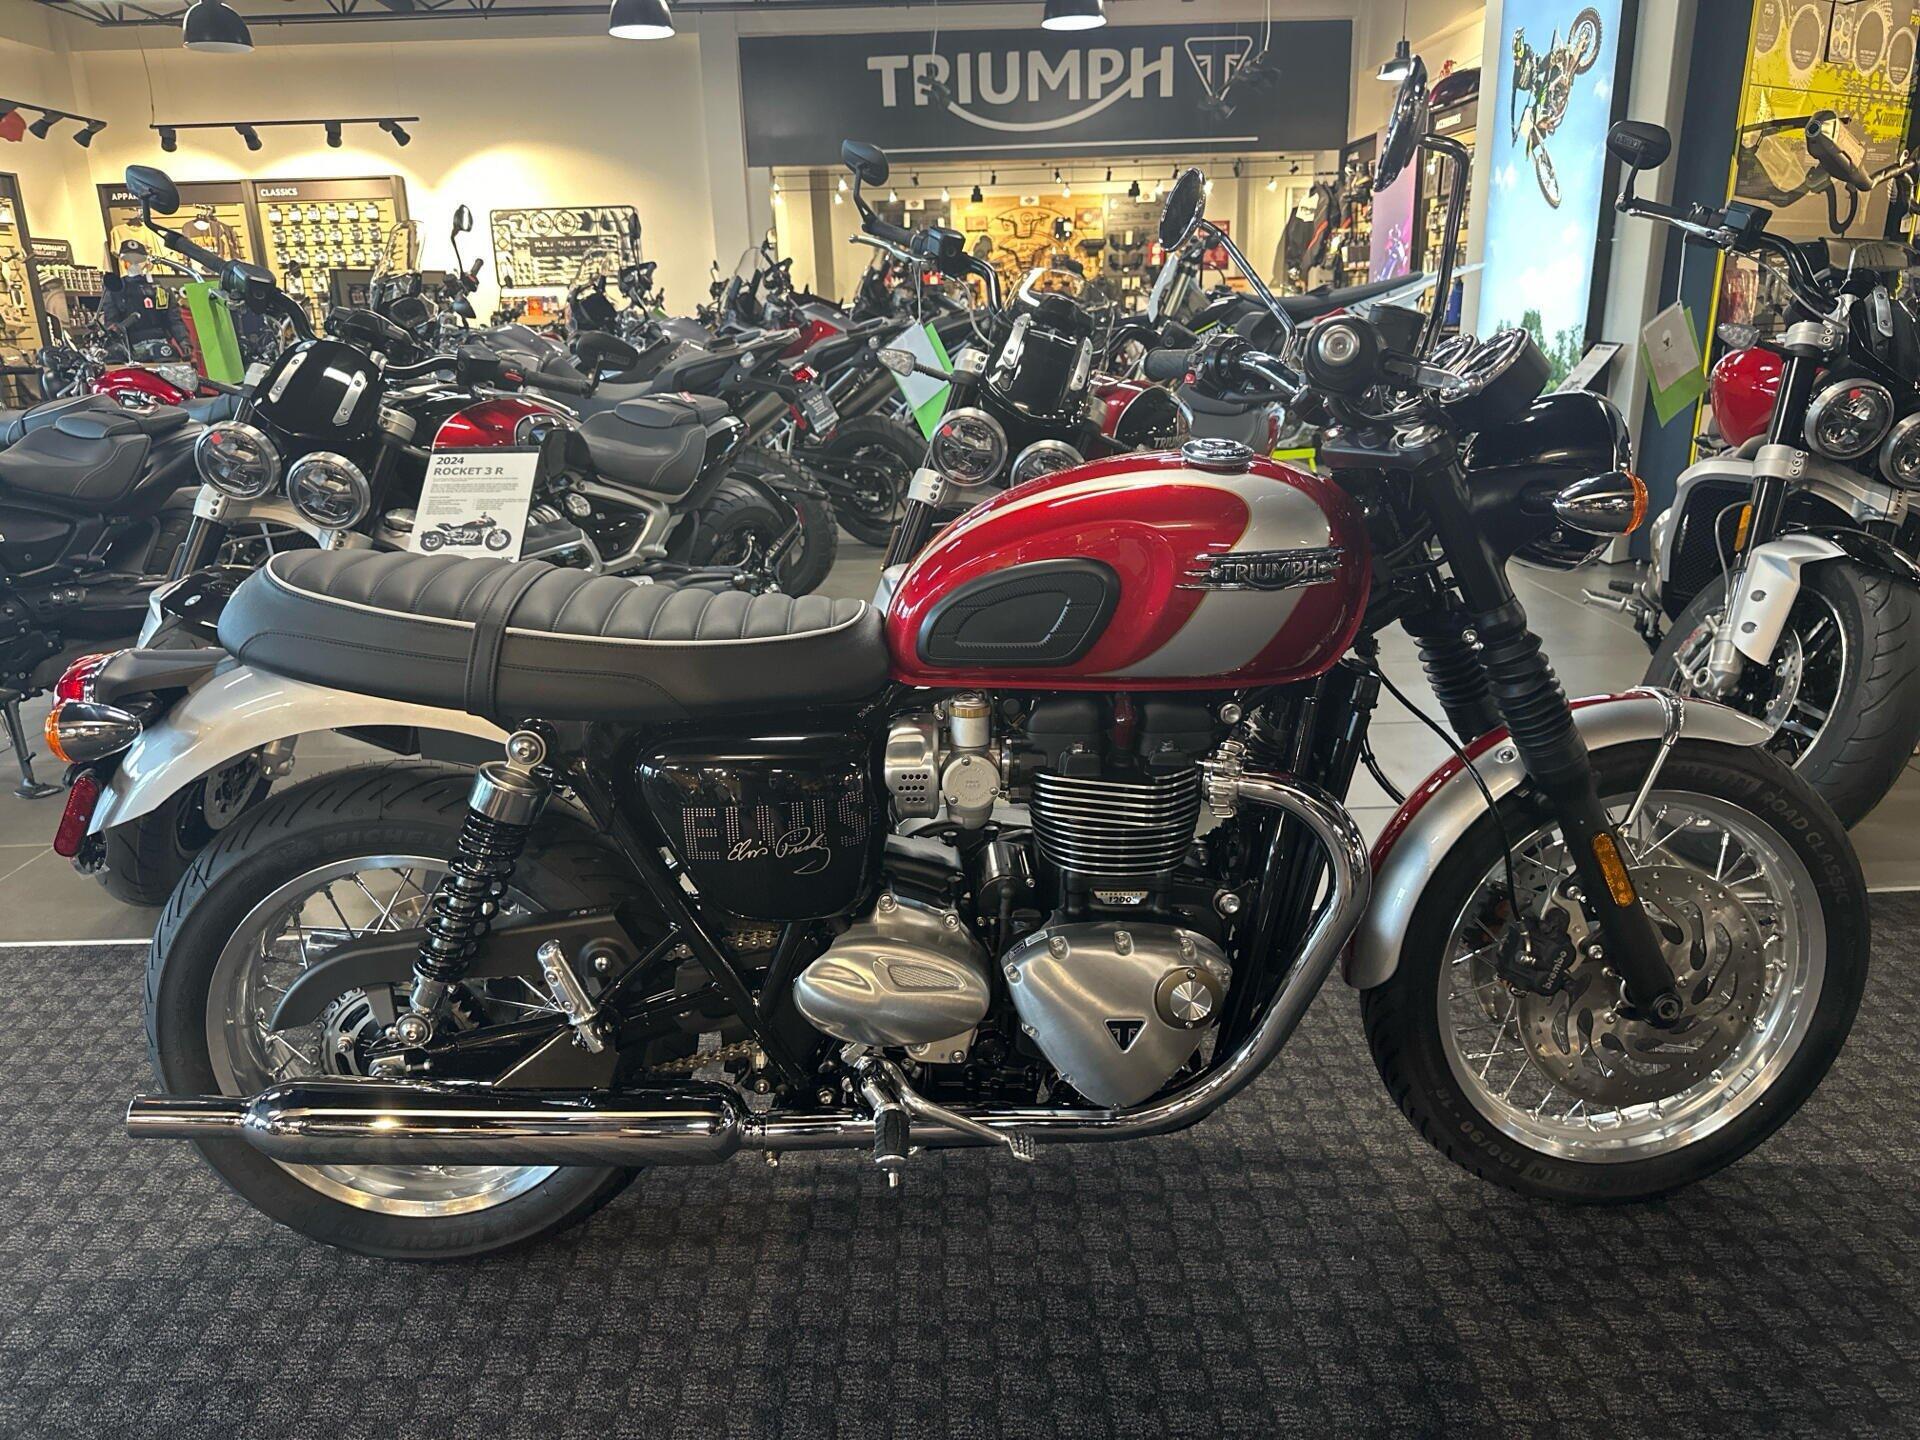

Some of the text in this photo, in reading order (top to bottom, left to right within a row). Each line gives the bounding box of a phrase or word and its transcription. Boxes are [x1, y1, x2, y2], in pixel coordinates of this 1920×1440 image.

[867, 46, 1174, 131] TRIUMPH
[112, 192, 139, 200] APPA
[261, 188, 298, 196] CLASSICS
[433, 467, 504, 475] ROCKET 3 R
[436, 457, 465, 465] 2024
[1220, 559, 1318, 588] TRIUMPH
[683, 791, 867, 860] ELVIS
[1764, 791, 1809, 831] ROAD
[1806, 831, 1849, 904] CLASSIC
[1542, 950, 1568, 989] brembo
